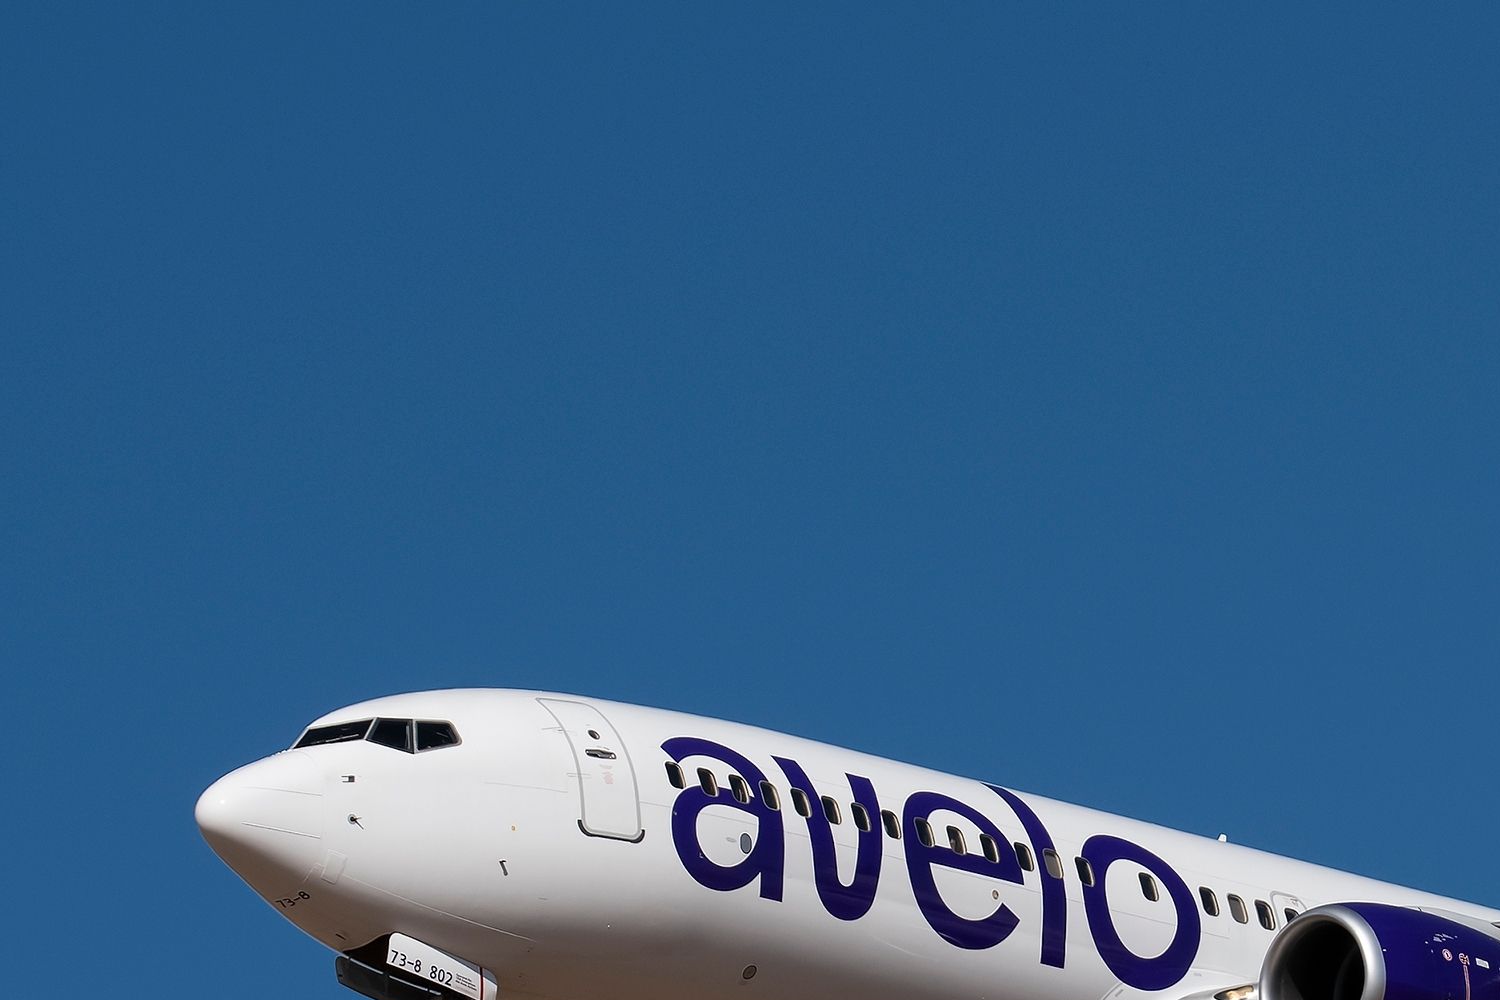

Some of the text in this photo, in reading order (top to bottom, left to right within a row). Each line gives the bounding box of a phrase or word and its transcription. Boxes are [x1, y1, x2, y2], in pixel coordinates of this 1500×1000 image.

[660, 736, 1201, 991] avelo
[274, 890, 310, 908] 73-8
[391, 949, 422, 973] 73-8
[429, 965, 453, 986] 802
